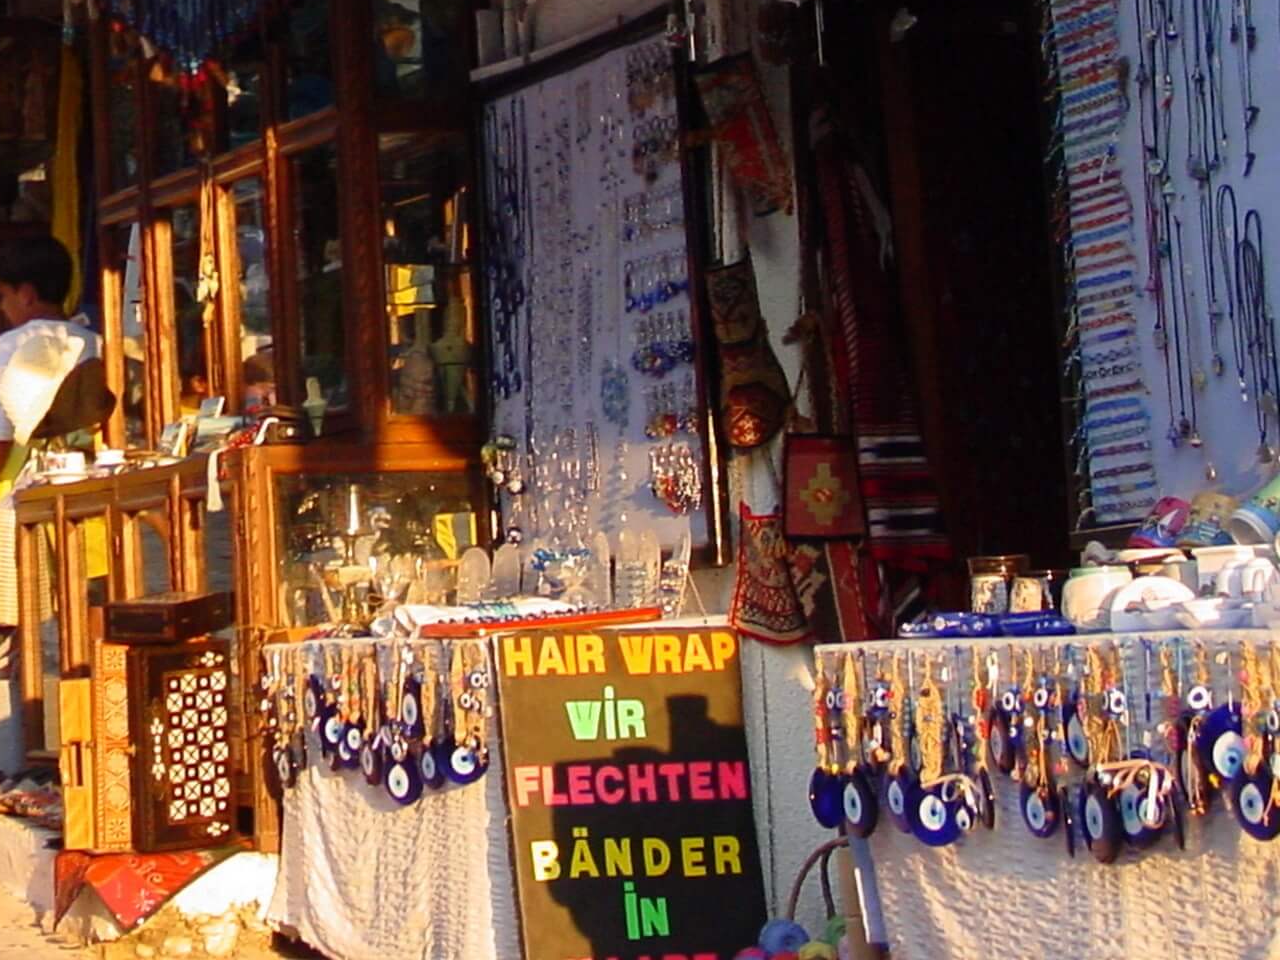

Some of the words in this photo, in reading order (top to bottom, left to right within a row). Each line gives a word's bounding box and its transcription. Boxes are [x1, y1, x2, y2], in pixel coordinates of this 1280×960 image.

[504, 635, 606, 677] HAIR
[618, 634, 736, 675] WRAP
[514, 761, 748, 807] FLECHTEN
[530, 827, 742, 881] BÄNDER
